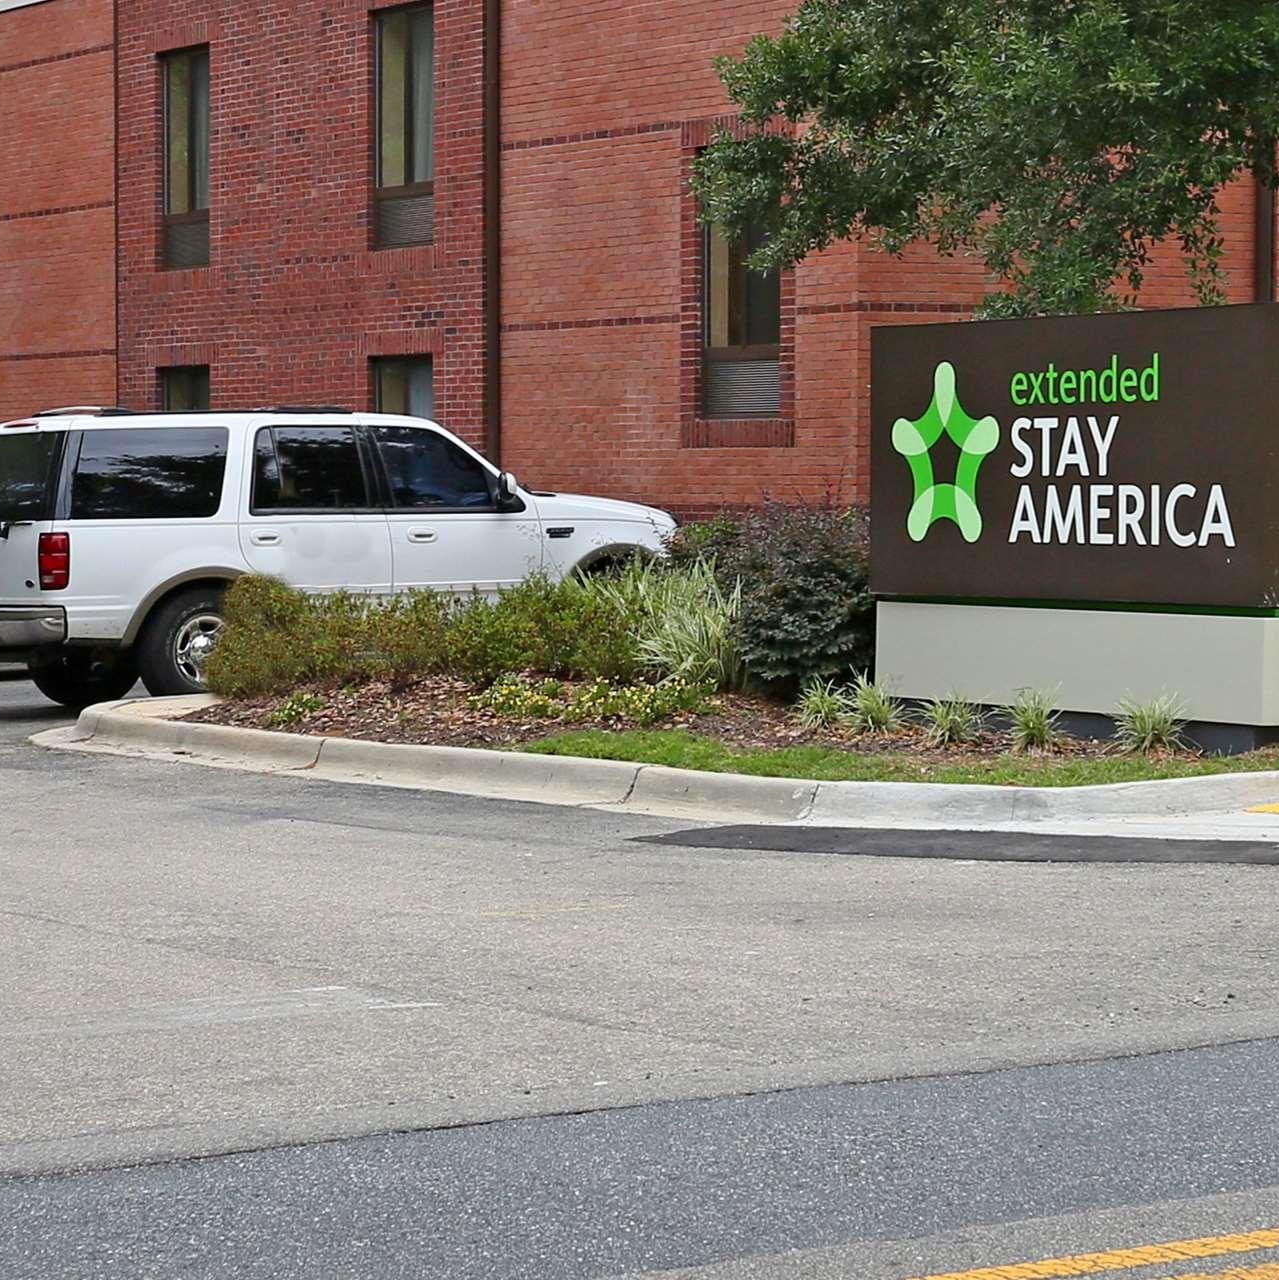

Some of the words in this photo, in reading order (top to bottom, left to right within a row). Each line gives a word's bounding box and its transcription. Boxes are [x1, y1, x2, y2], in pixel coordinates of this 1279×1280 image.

[1010, 352, 1160, 406] extended
[1010, 415, 1120, 478] STAY
[1007, 483, 1237, 548] AMERICA
